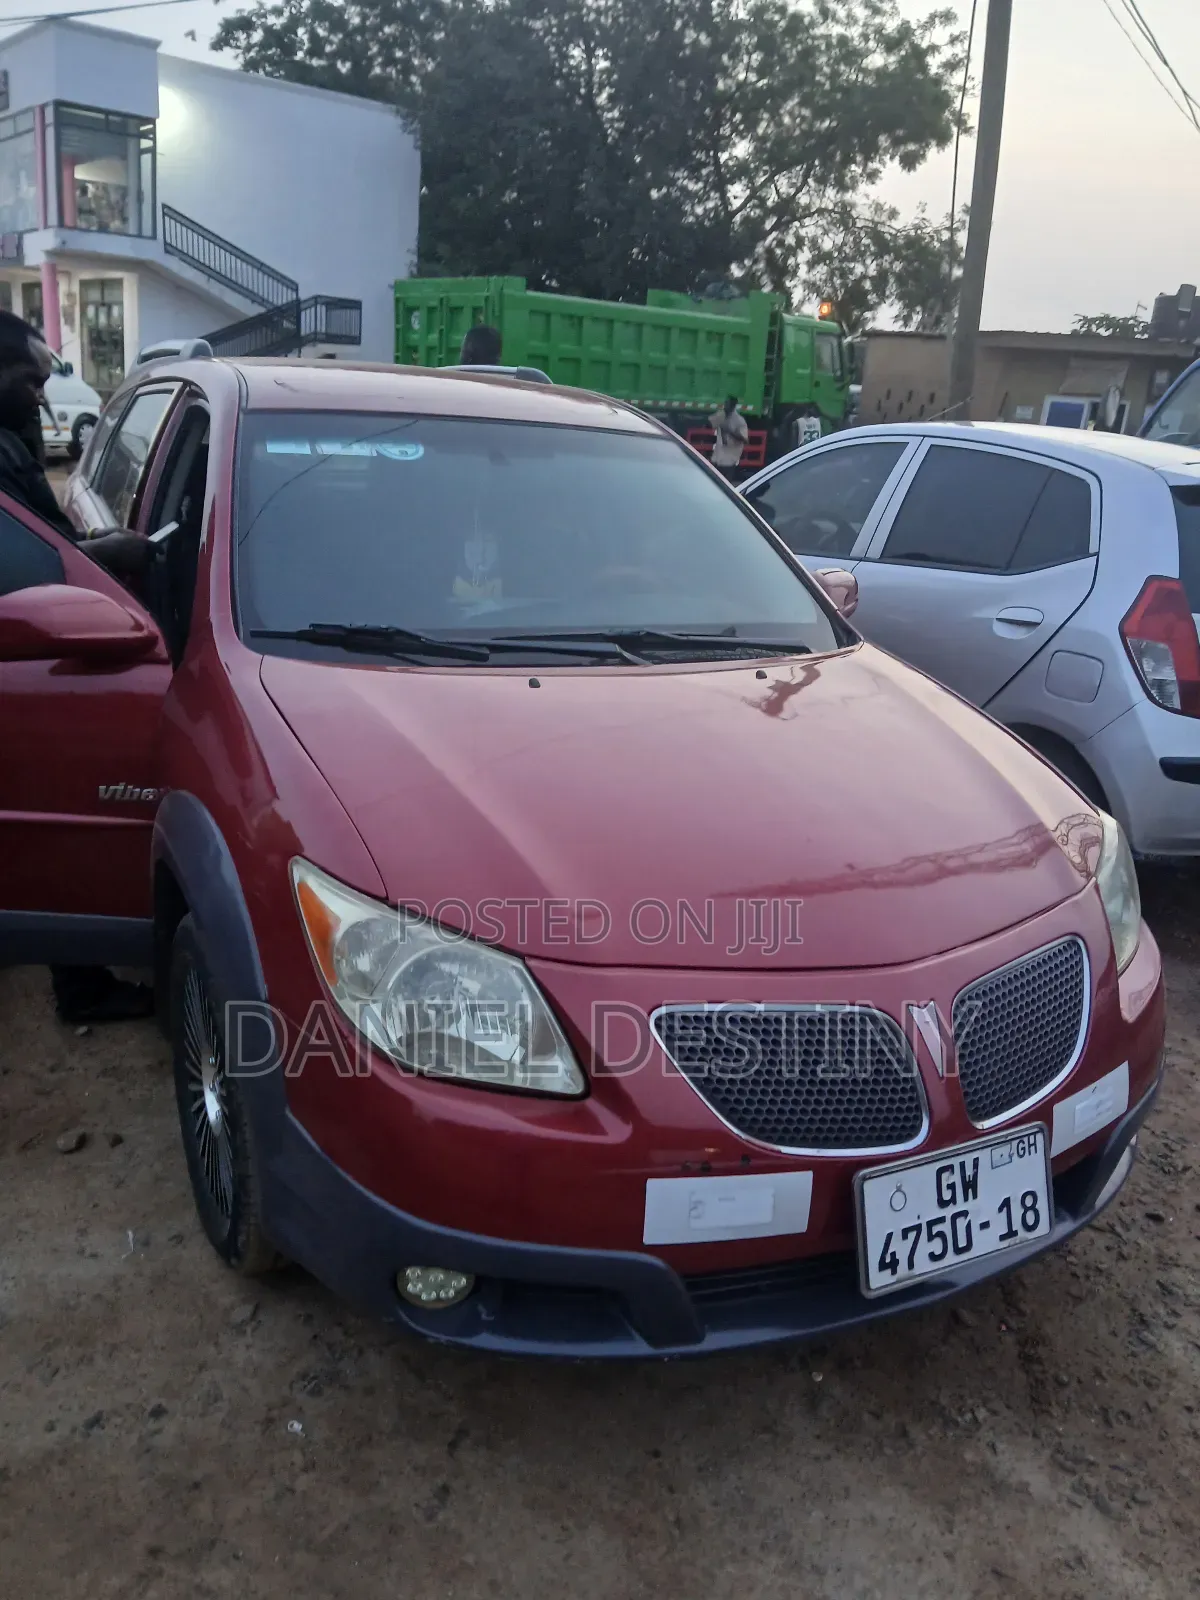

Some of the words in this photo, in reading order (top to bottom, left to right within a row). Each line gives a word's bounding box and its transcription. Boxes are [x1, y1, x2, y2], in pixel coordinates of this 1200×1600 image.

[1016, 1135, 1038, 1159] GH
[935, 1156, 980, 1209] GW
[878, 1190, 1041, 1276] 4750-18
